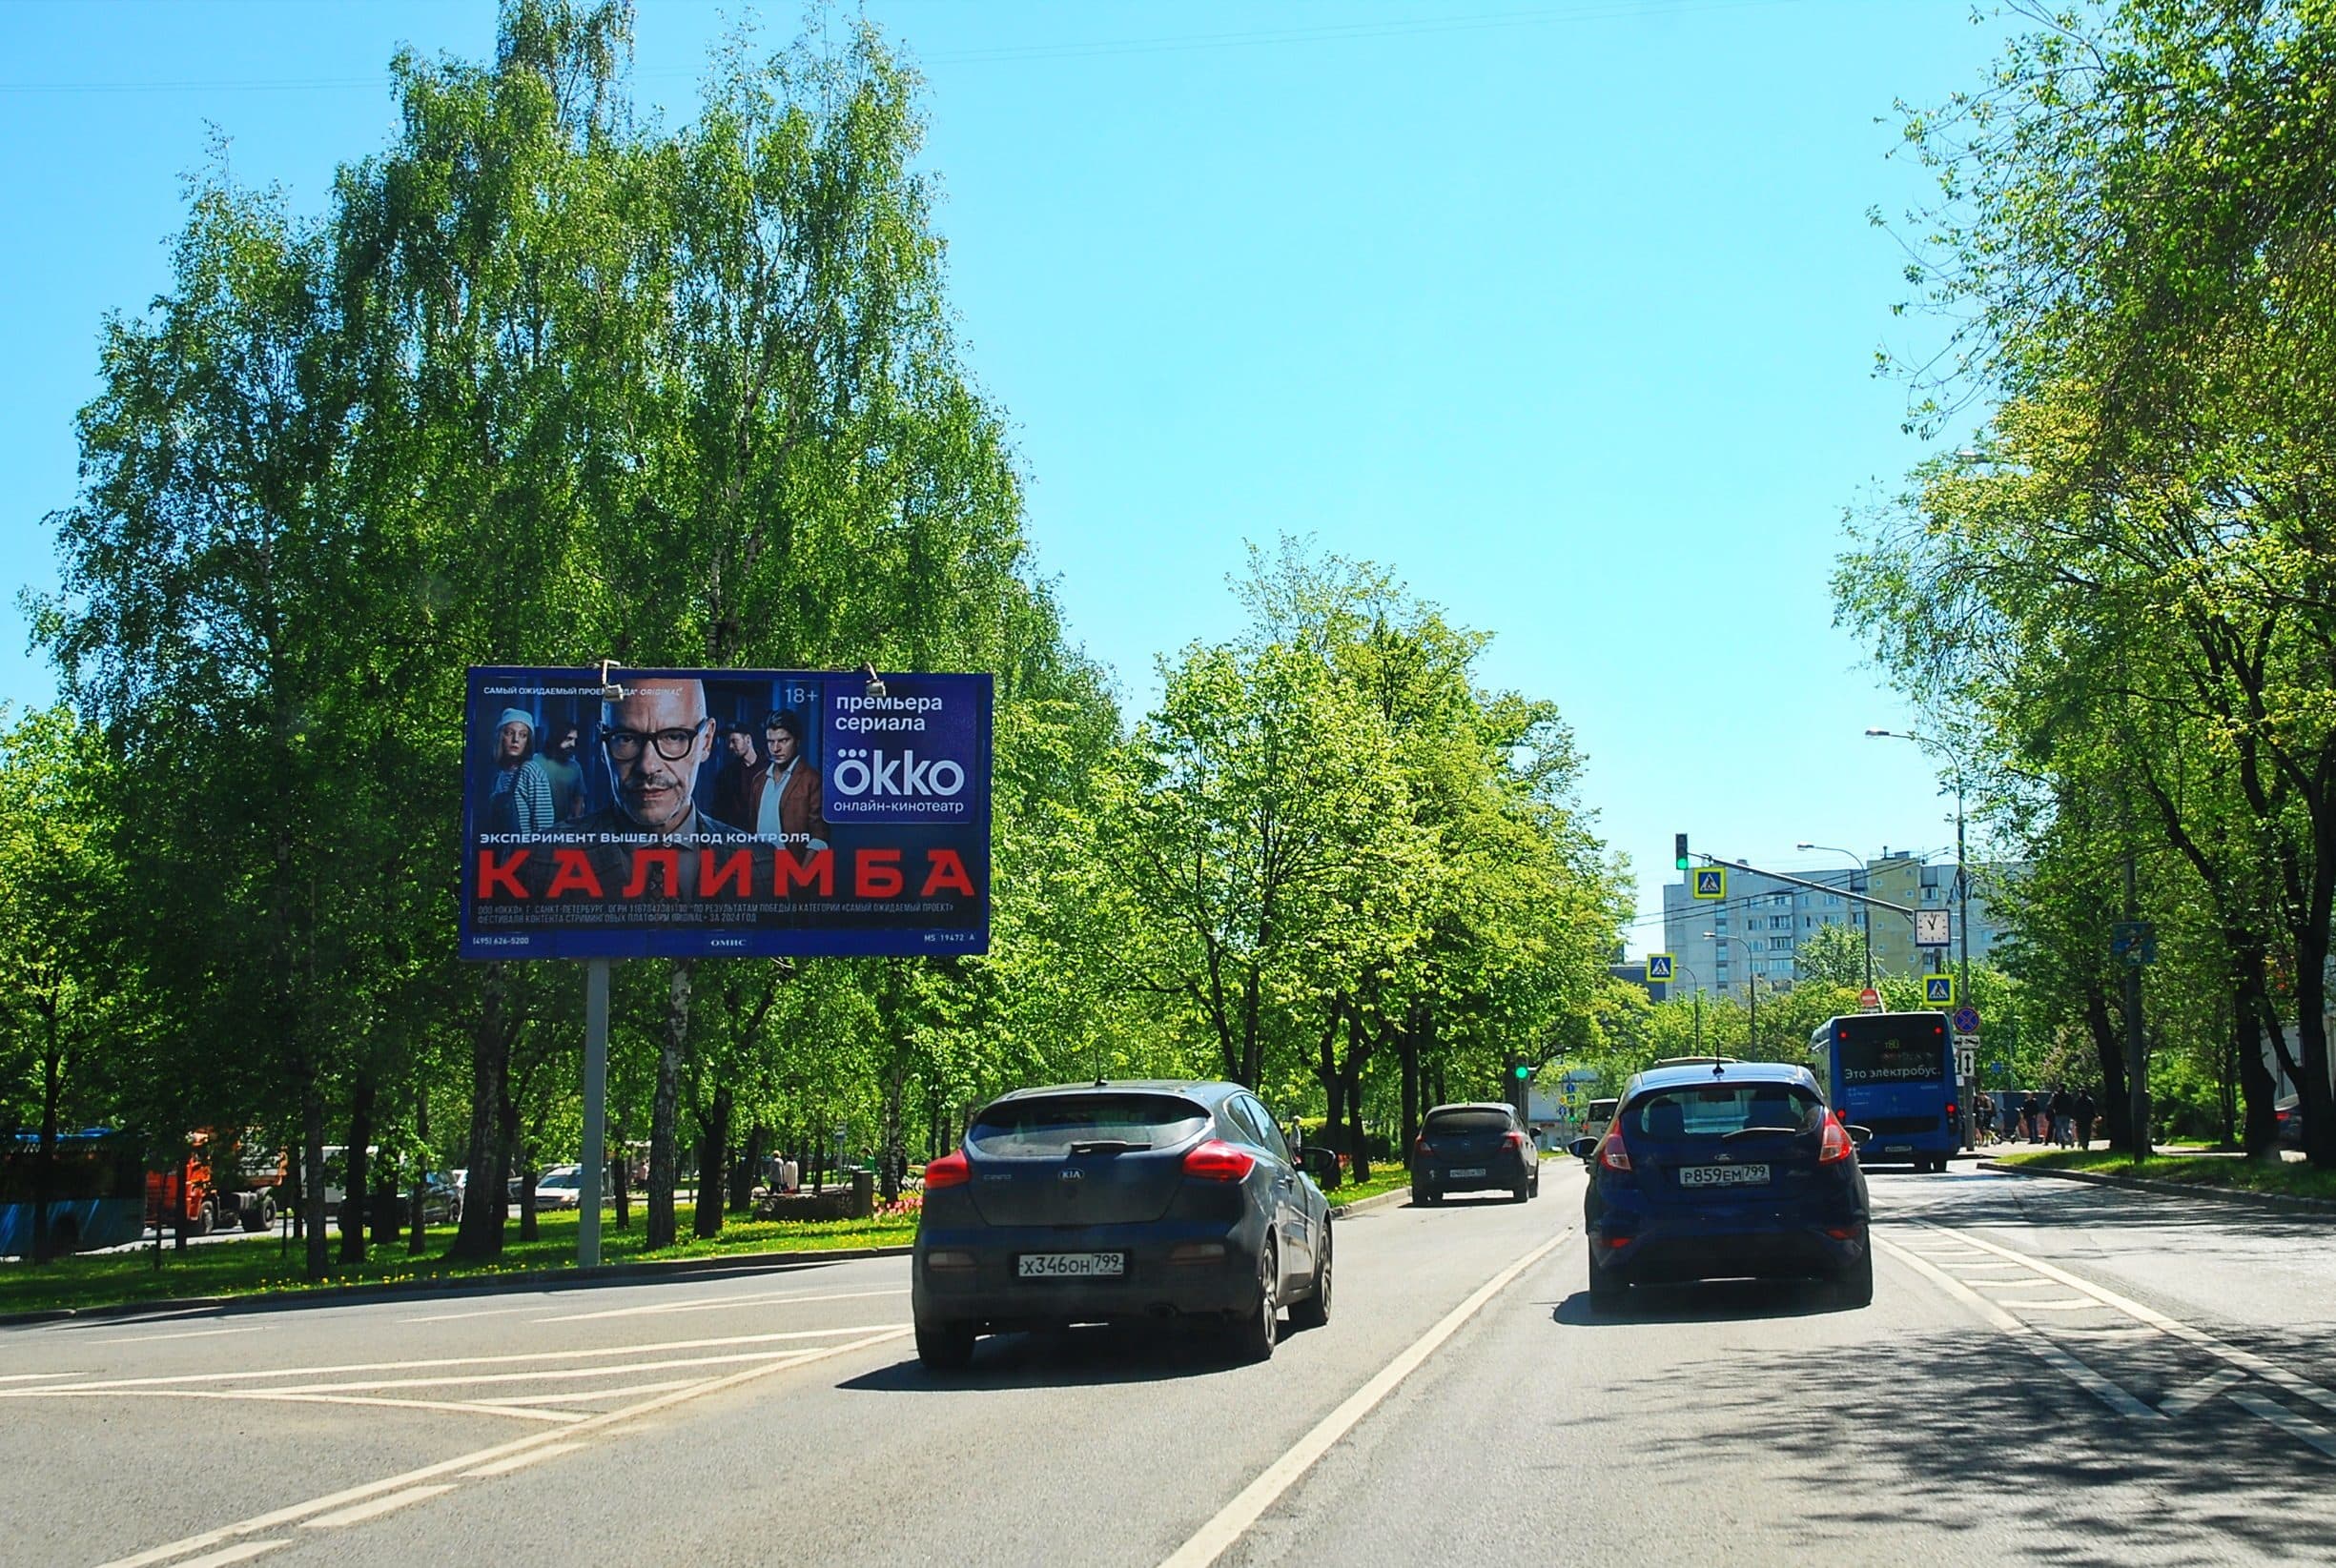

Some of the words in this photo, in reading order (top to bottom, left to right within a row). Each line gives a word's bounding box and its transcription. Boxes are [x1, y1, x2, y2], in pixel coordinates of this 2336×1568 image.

[483, 685, 517, 695] САМЫЙ
[519, 685, 577, 696] ОЖИДАЕМЫЙ
[579, 687, 604, 696] ПРОЕ
[785, 687, 819, 704] 18+
[836, 696, 943, 714] премьера
[835, 717, 926, 734] сериала
[833, 800, 964, 814] онлайн-кинотеатр
[480, 833, 596, 844] ЭКСПЕРИМЕНТ
[601, 833, 659, 844] ВЫШЕЛ
[663, 833, 723, 845] ИЗ-ПОД
[727, 833, 810, 844] КОНТРОЛЯ
[478, 848, 975, 899] КАЛИМБА
[706, 903, 758, 912] РЕЗУЛЬТАТАМ
[759, 903, 790, 912] ПОБЕДЫ
[799, 903, 840, 912] КАТЕГОРИИ
[873, 902, 921, 913] ОЖИДАЕМЫЙ
[1845, 1069, 1867, 1079] Это
[1868, 1064, 1941, 1078] электробус.
[1062, 1171, 1081, 1181] KIA
[1685, 1168, 1741, 1183] Р859ЕМ
[1744, 1166, 1766, 1177] 799
[1024, 1256, 1090, 1273] Х346ОН
[1094, 1254, 1119, 1269] 799
